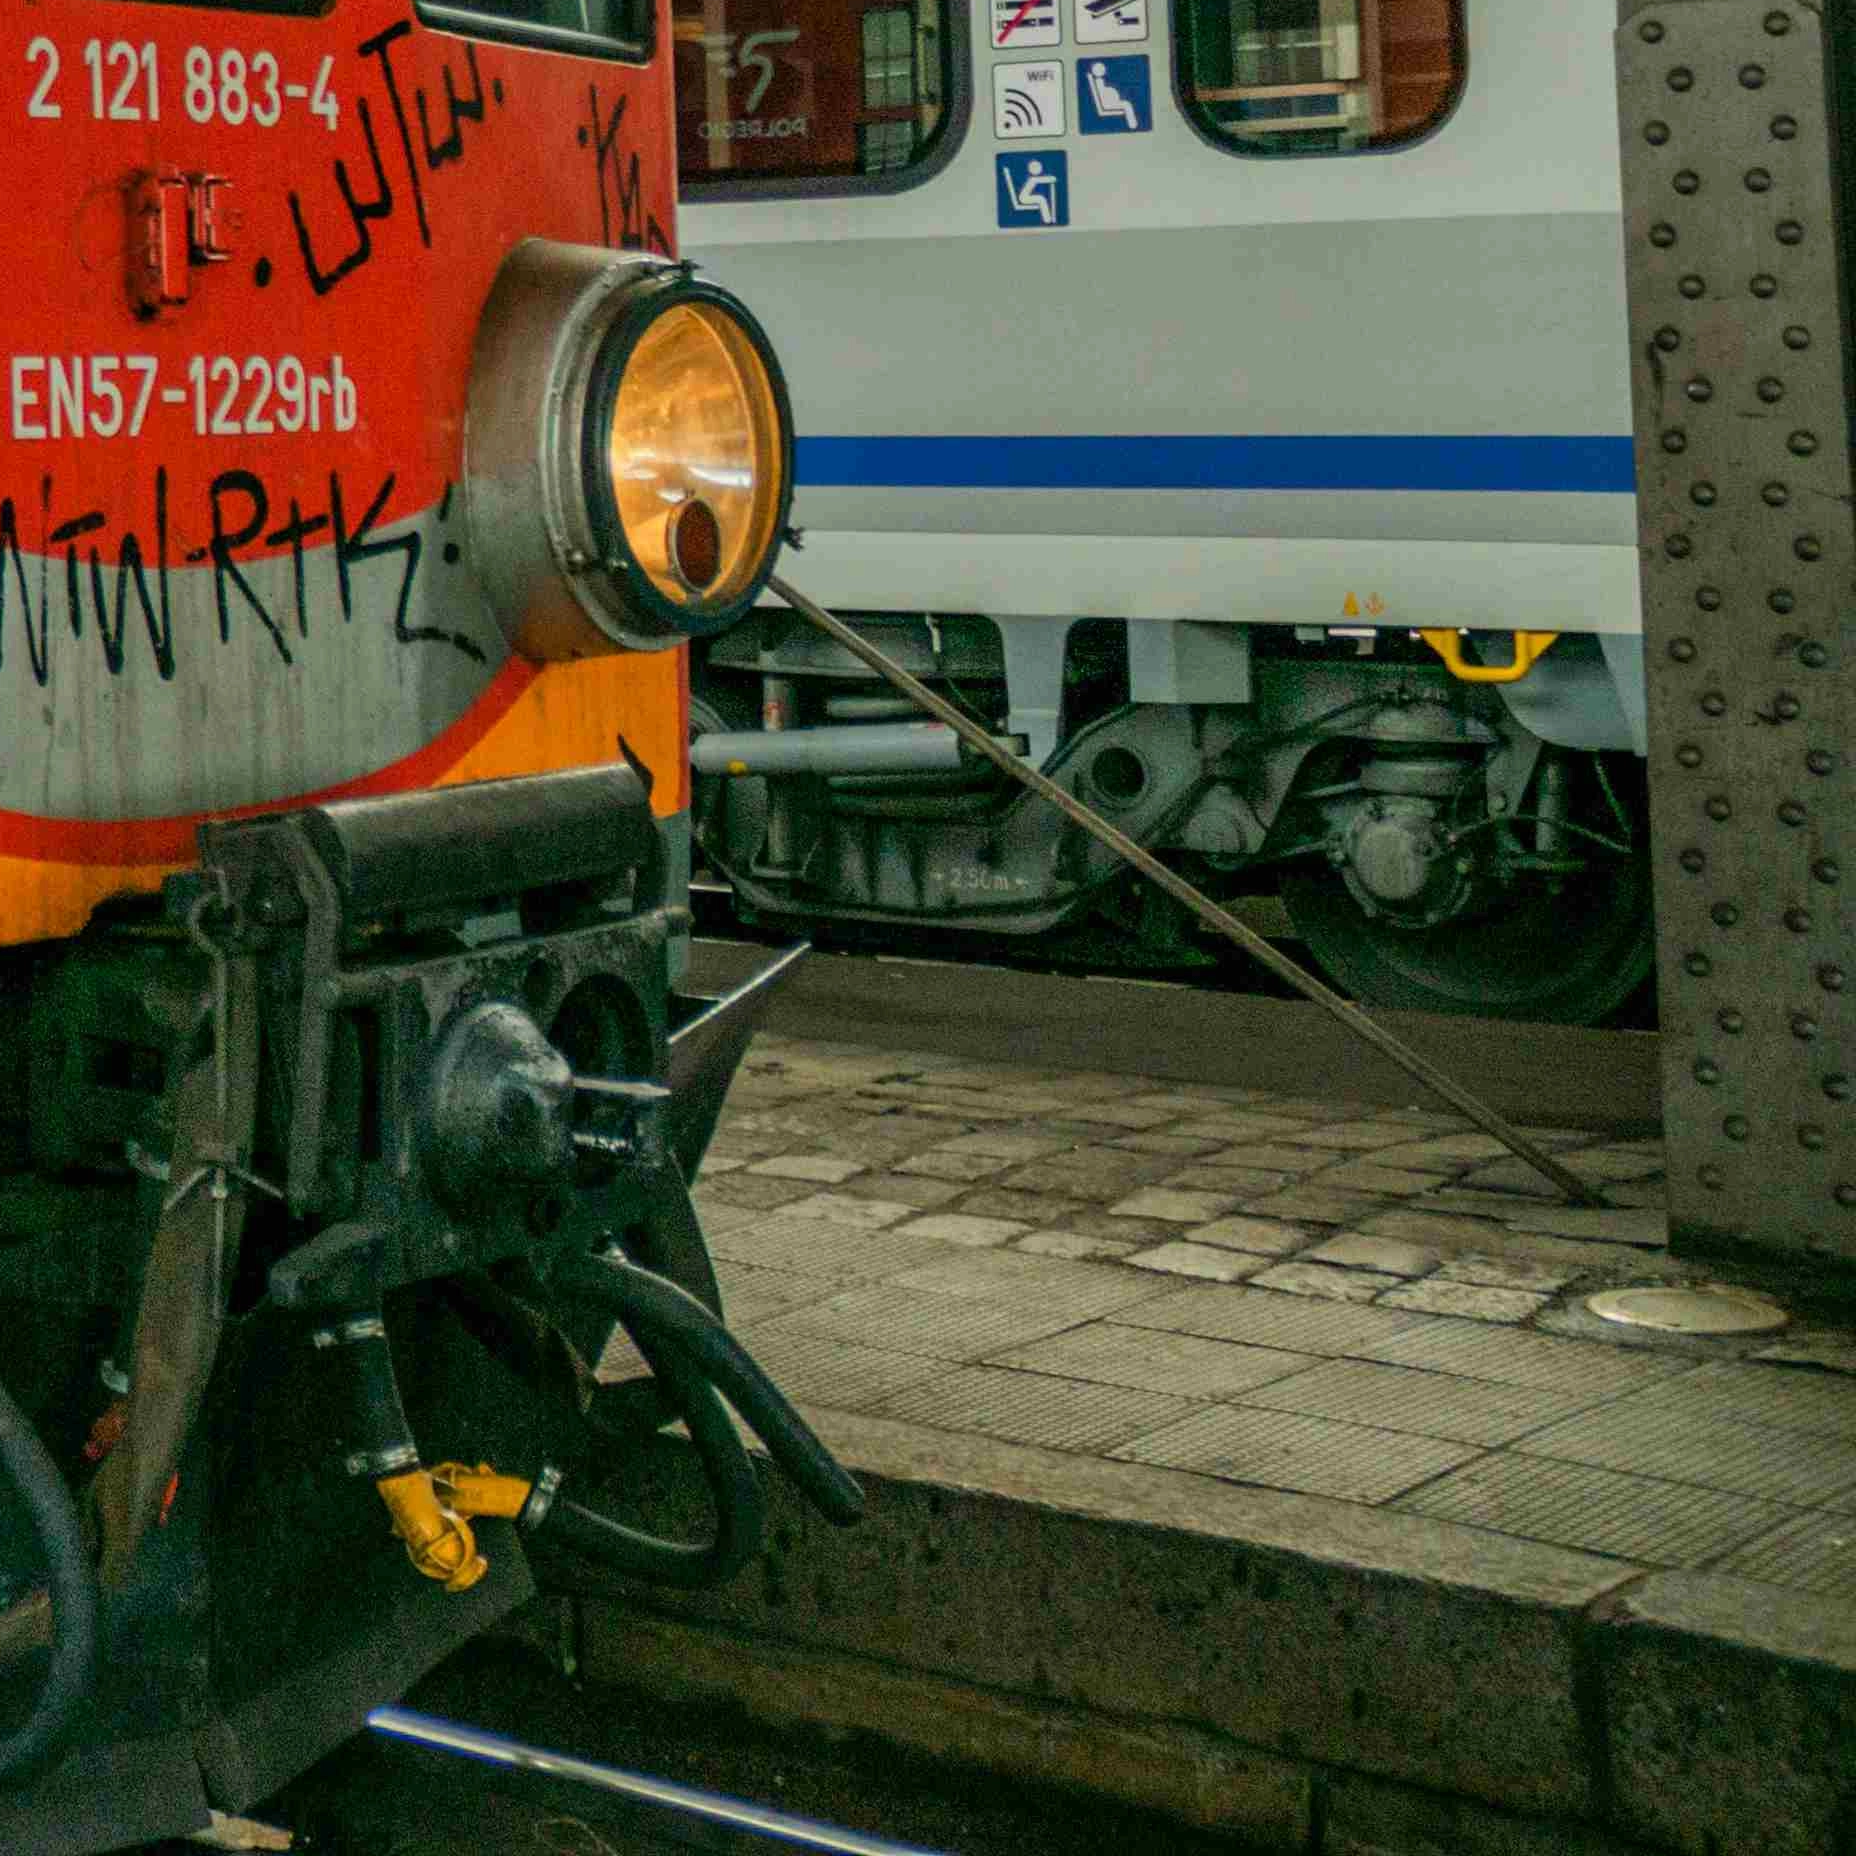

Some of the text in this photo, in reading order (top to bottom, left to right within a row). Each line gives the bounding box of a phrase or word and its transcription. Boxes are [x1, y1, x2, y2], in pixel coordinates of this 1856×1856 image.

[25, 36, 340, 131] 2 121 883-4
[1026, 69, 1056, 83] WiFi
[11, 355, 359, 441] EN57-1229rb
